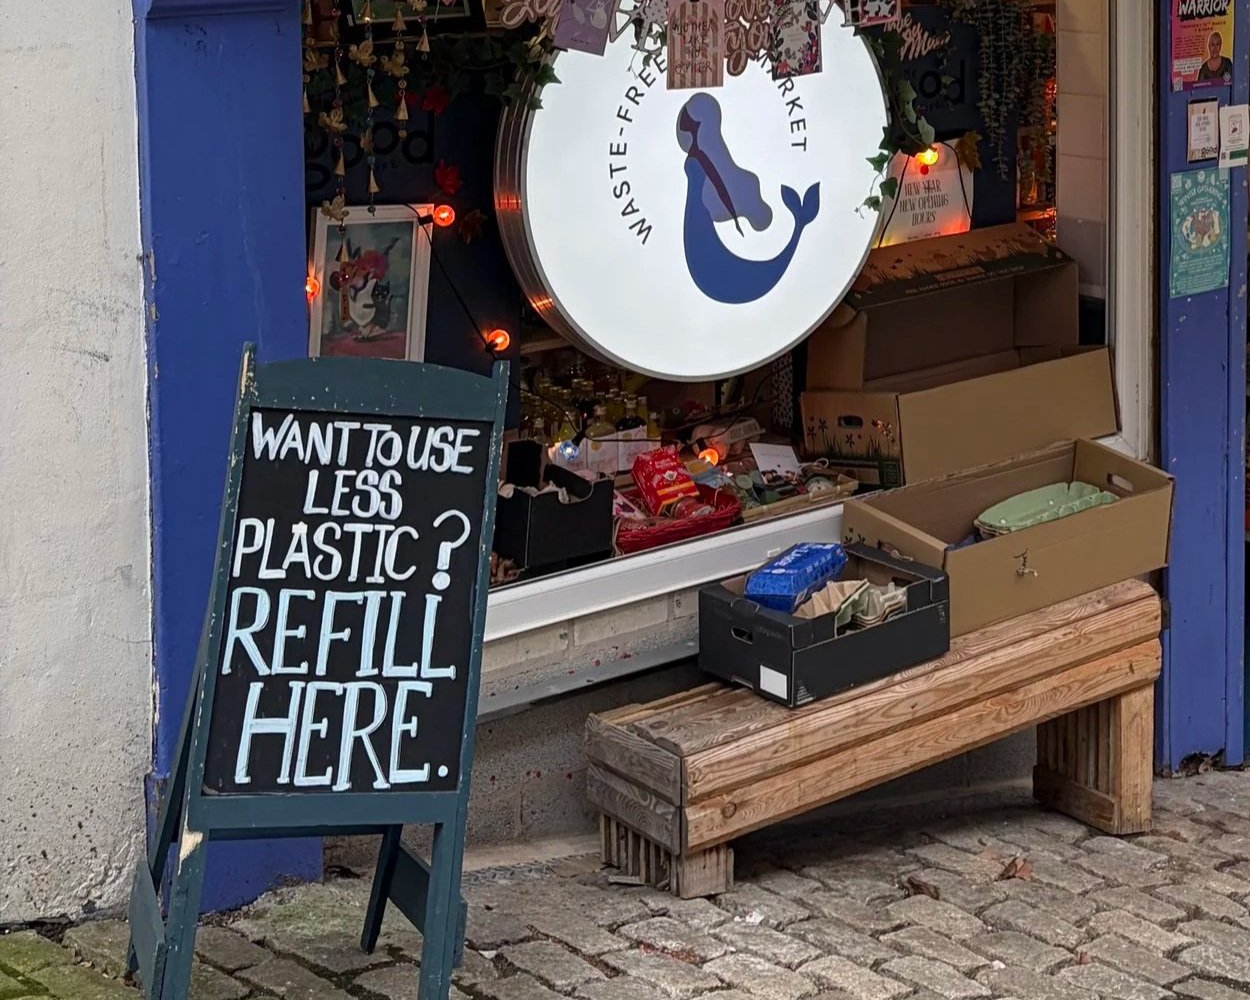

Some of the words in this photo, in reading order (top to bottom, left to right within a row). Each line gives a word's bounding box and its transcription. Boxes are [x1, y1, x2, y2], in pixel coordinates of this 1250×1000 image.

[608, 53, 668, 247] WASTE-FREE
[900, 198, 917, 213] NEW
[918, 193, 949, 211] OPENING
[904, 182, 921, 197] NEW
[922, 178, 942, 194] YEAR
[912, 210, 937, 227] HOURS
[251, 412, 362, 467] WANT
[362, 421, 403, 470] TO
[406, 424, 481, 475] USE
[302, 468, 404, 520] LESS
[220, 586, 457, 681] REFILL
[233, 680, 450, 793] HERE.
